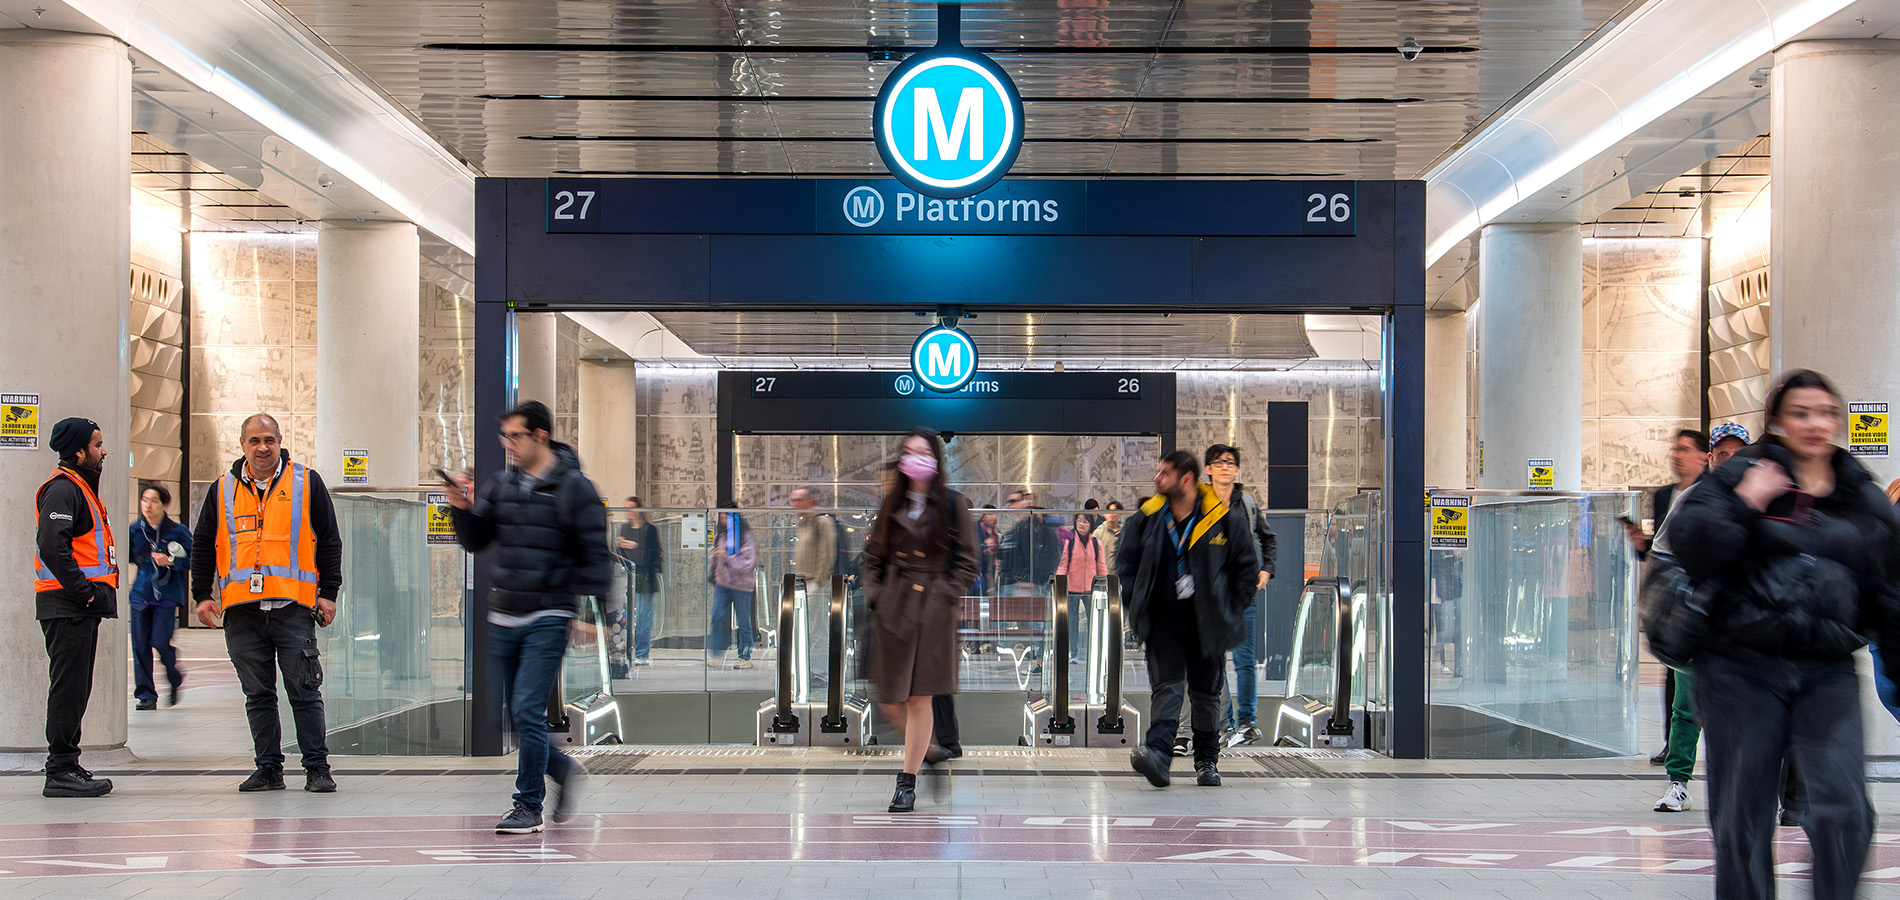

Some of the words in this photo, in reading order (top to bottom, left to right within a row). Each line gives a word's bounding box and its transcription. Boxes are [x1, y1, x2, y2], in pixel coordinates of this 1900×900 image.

[914, 87, 984, 161] M
[553, 191, 596, 220] 27
[896, 192, 1059, 222] Platforms
[1306, 193, 1350, 222] 26
[928, 343, 961, 377] M
[755, 377, 777, 392] 27
[1117, 378, 1140, 393] 26
[2, 395, 38, 404] WARNING
[1850, 404, 1887, 412] WARNING
[1433, 498, 1467, 506] WARNING
